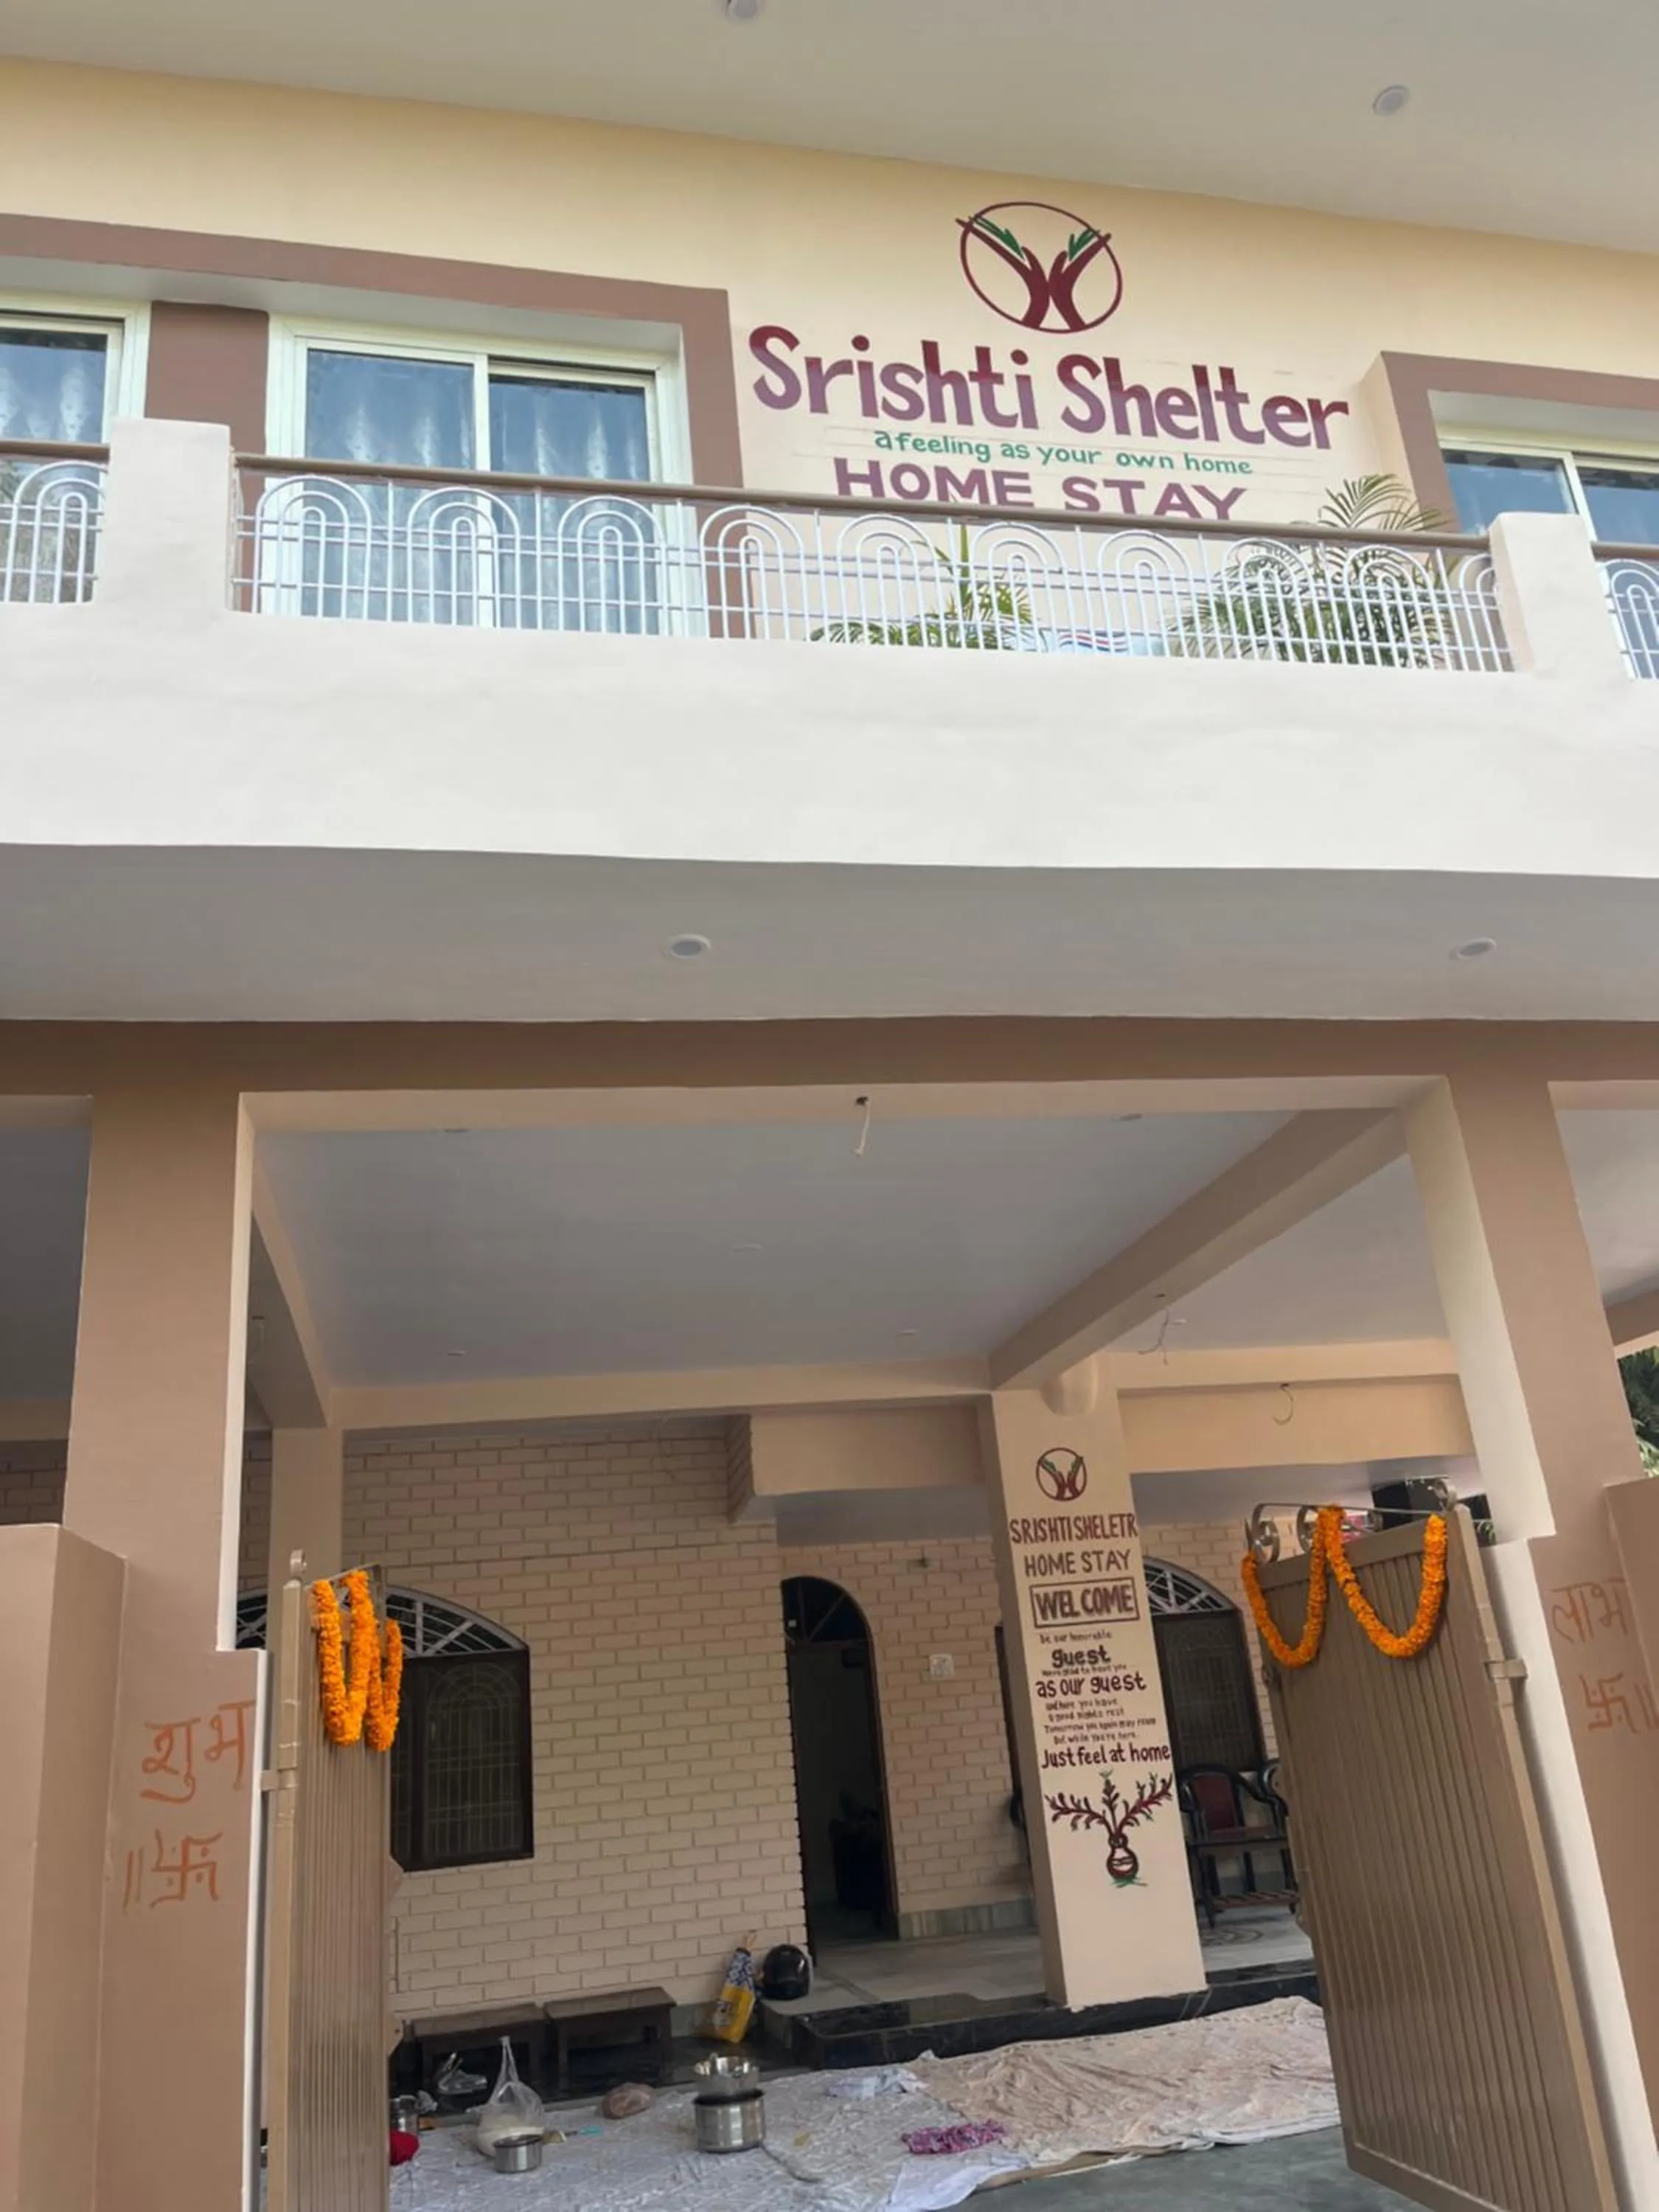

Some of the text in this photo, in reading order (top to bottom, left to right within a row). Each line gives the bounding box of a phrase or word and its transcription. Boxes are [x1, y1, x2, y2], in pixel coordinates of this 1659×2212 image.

[748, 325, 1349, 449] Srishti Shelter
[1001, 443, 1031, 460] as
[1037, 446, 1102, 466] your
[1116, 451, 1175, 470] own
[1183, 452, 1253, 474] home
[834, 457, 1248, 521] HOME STAY
[1009, 1516, 1072, 1545] SRISHTI
[1024, 1549, 1131, 1577] HOME STAY
[1035, 1585, 1134, 1621] WELCOME
[1551, 1576, 1629, 1644] लाभ
[1051, 1644, 1111, 1668] guest
[1035, 1672, 1147, 1698] as our guest
[139, 1700, 256, 1804] शुभ
[1042, 1742, 1171, 1770] Just feel at home
